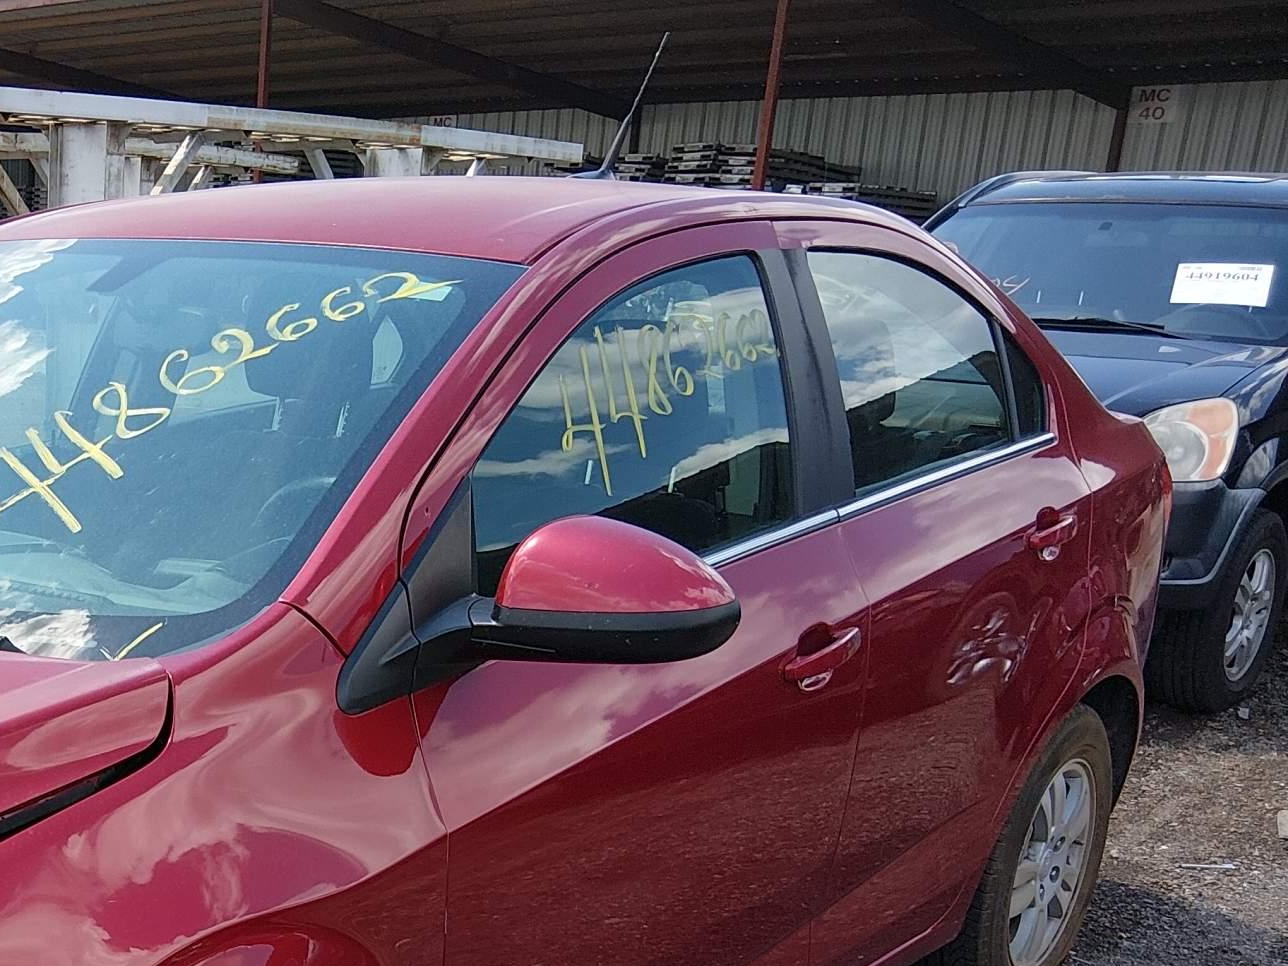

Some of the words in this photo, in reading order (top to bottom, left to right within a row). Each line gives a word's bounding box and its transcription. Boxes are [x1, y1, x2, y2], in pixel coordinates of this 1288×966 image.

[1139, 88, 1171, 102] MC
[1138, 106, 1166, 120] 40
[433, 116, 453, 127] MC
[1185, 271, 1260, 281] 44919604
[560, 309, 781, 497] 44862662
